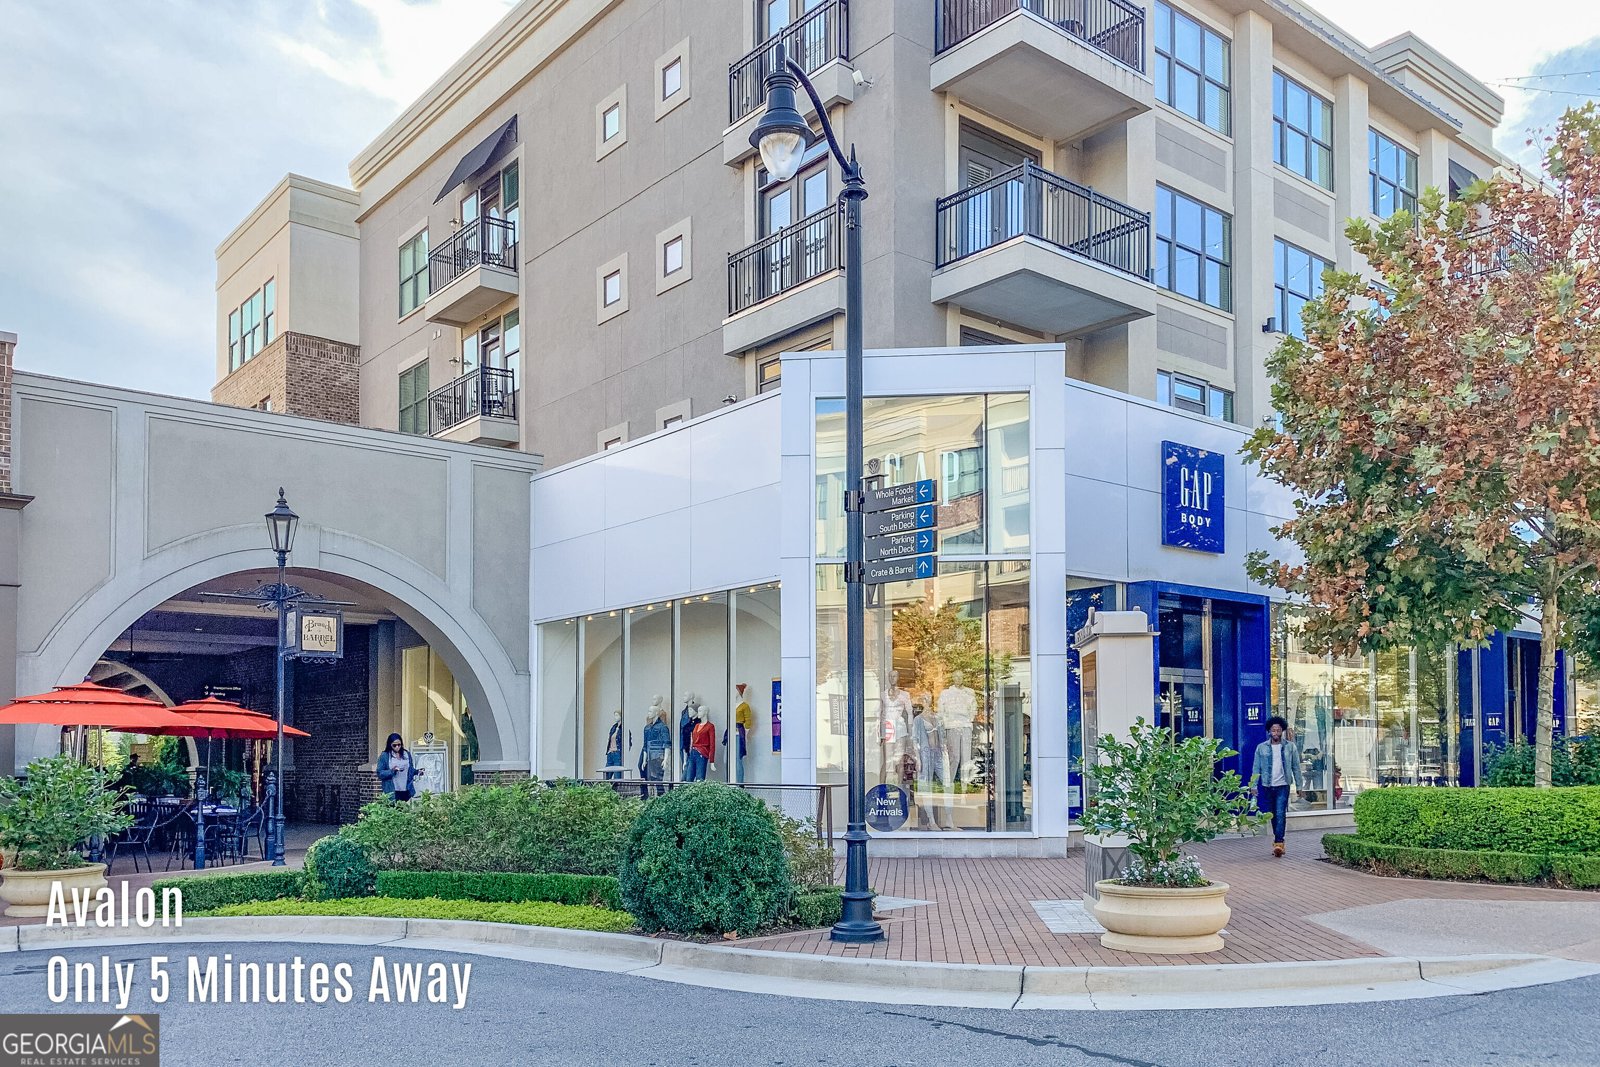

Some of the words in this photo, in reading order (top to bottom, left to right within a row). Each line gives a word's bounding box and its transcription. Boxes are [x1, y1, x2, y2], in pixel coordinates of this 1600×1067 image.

[875, 489, 895, 500] Whole
[895, 485, 915, 496] Foods
[1180, 466, 1212, 511] GAP
[891, 495, 915, 506] Market
[891, 511, 915, 522] Parking
[1181, 512, 1211, 528] BODY
[879, 523, 898, 533] South
[898, 519, 915, 530] Deck
[891, 535, 915, 545] Parking
[880, 546, 898, 556] North
[898, 544, 915, 554] Deck
[870, 568, 888, 578] Crate
[888, 566, 894, 576] &
[894, 564, 914, 575] Barrel
[1488, 717, 1500, 727] GAP
[876, 797, 896, 806] New
[868, 807, 904, 817] Arrivals
